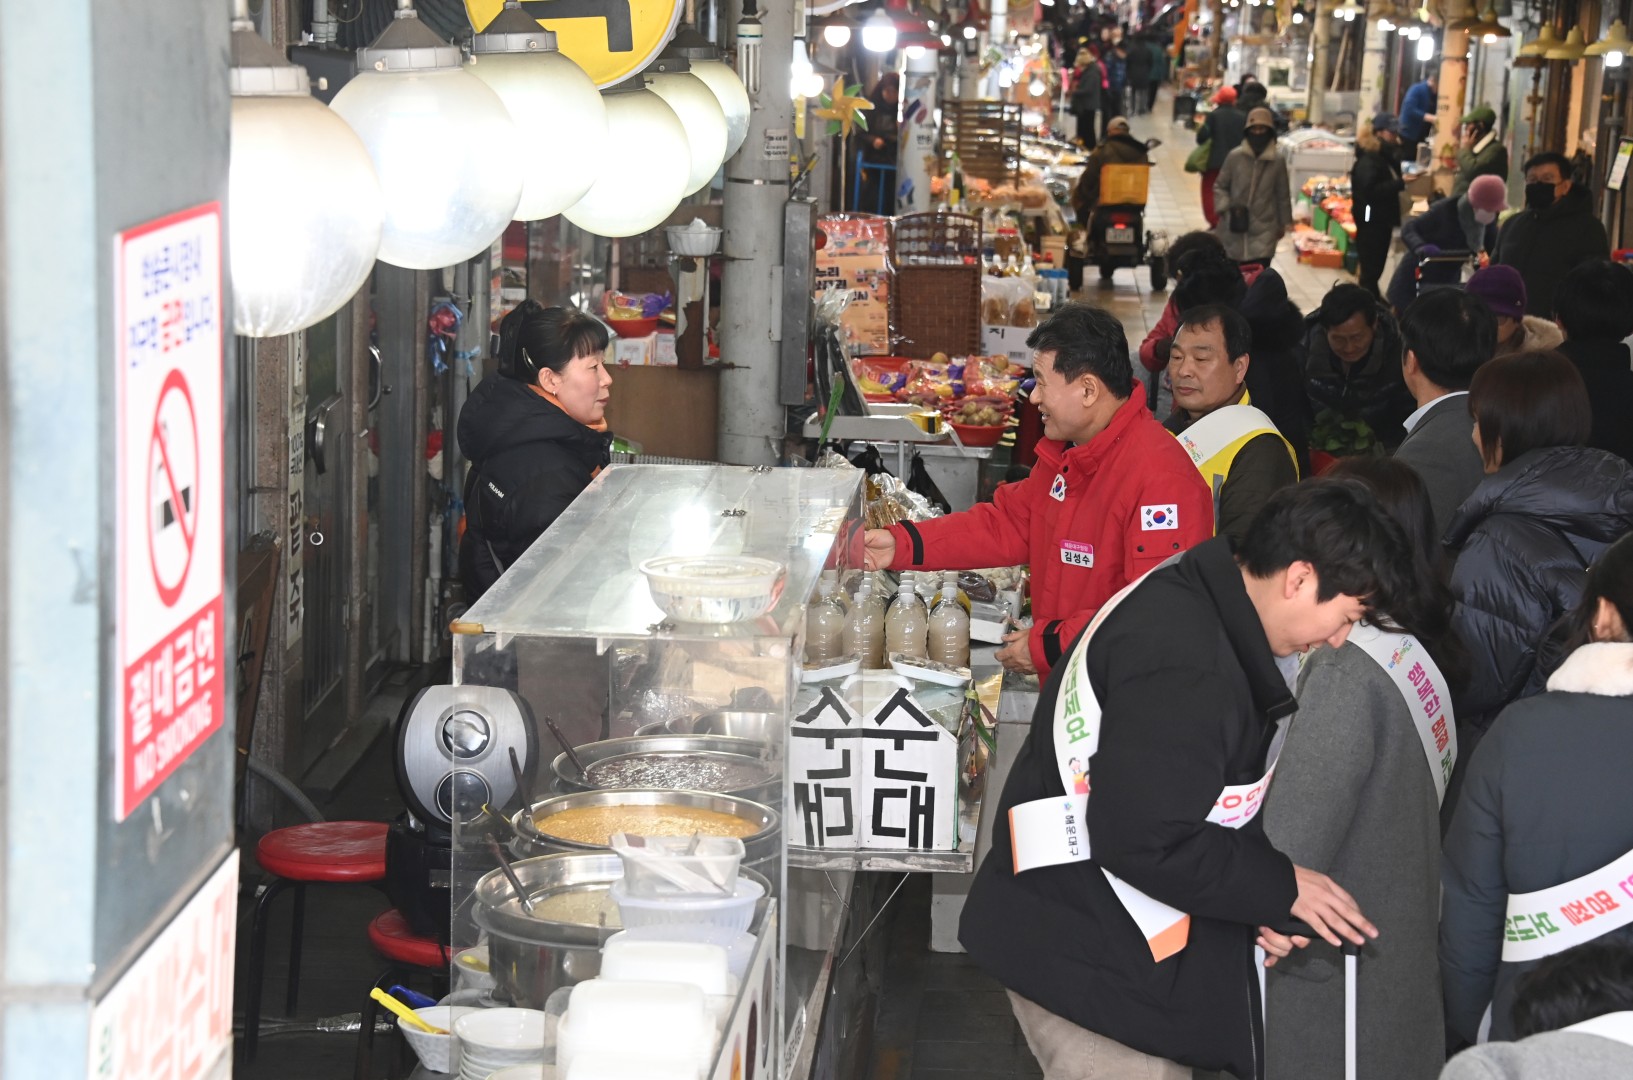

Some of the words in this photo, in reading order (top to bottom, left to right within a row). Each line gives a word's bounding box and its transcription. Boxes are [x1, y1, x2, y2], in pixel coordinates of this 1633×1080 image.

[1064, 551, 1090, 565] 김성수
[130, 611, 216, 745] 절대금연
[1407, 661, 1441, 719] 행복한
[1430, 713, 1450, 754] 명절
[134, 744, 155, 792] NO
[156, 690, 213, 784] SMOKING
[862, 687, 940, 849] 순대
[1064, 814, 1080, 857] 해운대구
[1559, 888, 1621, 927] 명절
